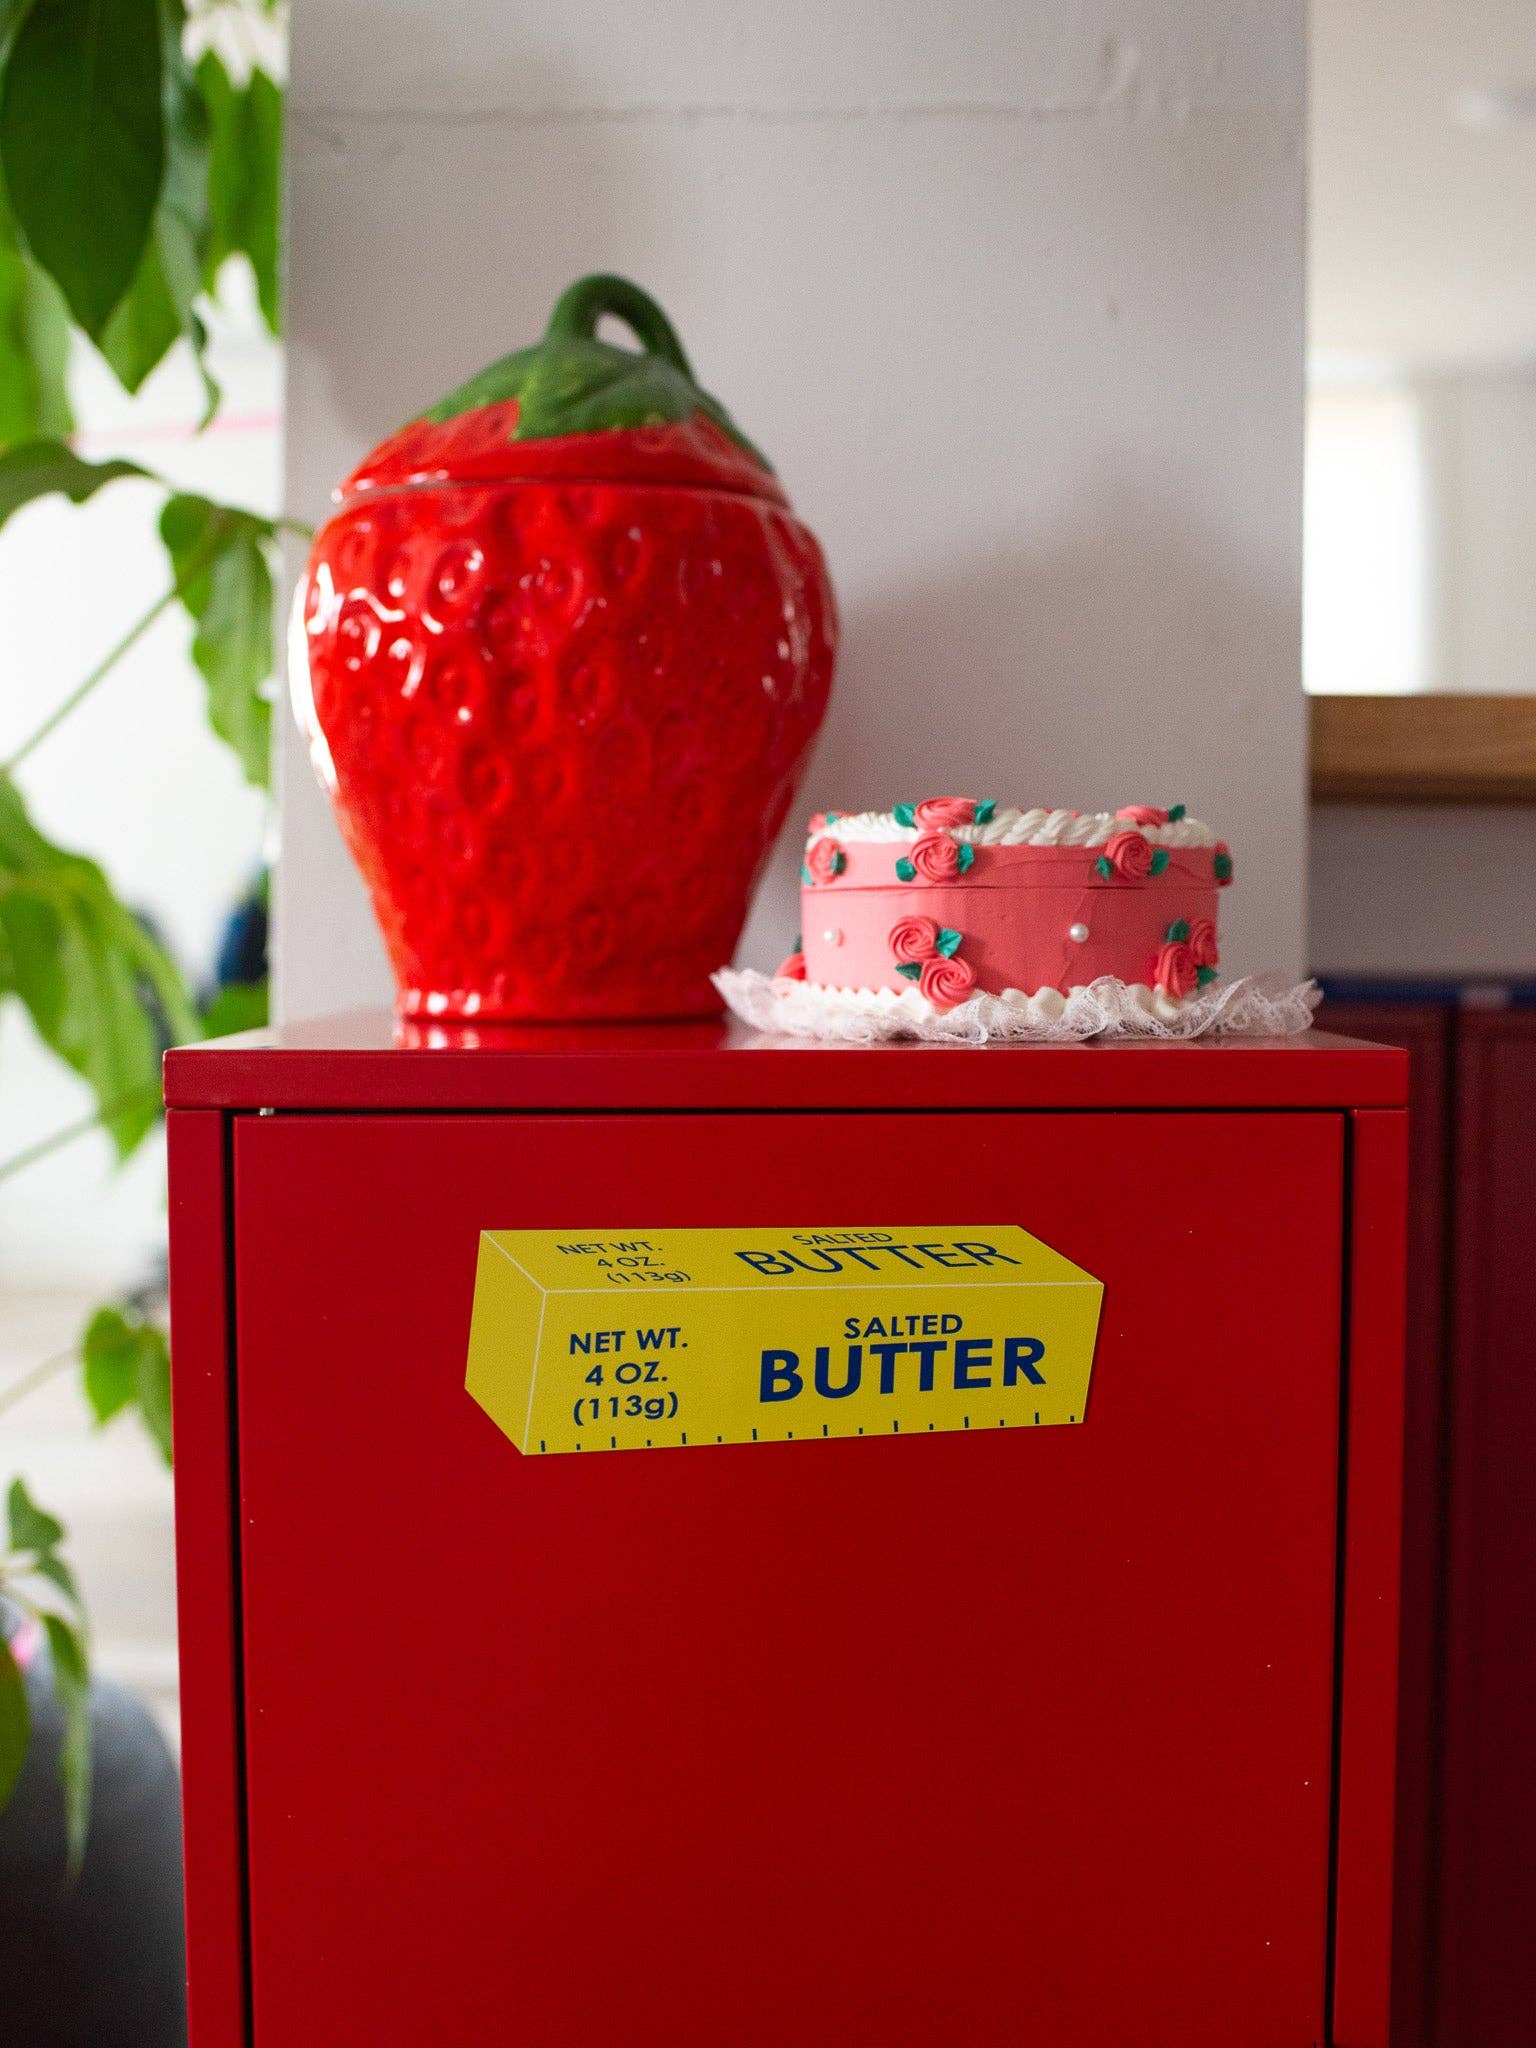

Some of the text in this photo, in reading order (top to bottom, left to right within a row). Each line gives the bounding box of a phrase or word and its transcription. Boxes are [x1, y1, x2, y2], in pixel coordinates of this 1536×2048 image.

[556, 1241, 663, 1255] NET WT.
[792, 1232, 893, 1246] SALTED
[597, 1256, 665, 1268] 4 OZ.
[734, 1242, 1023, 1276] BUTTER
[606, 1270, 692, 1284] (113g)
[843, 1313, 963, 1339] SALTED
[569, 1327, 688, 1355] NET WT.
[585, 1361, 668, 1387] 4 OZ.
[759, 1337, 1047, 1403] BUTTER
[573, 1391, 679, 1426] (113g)
